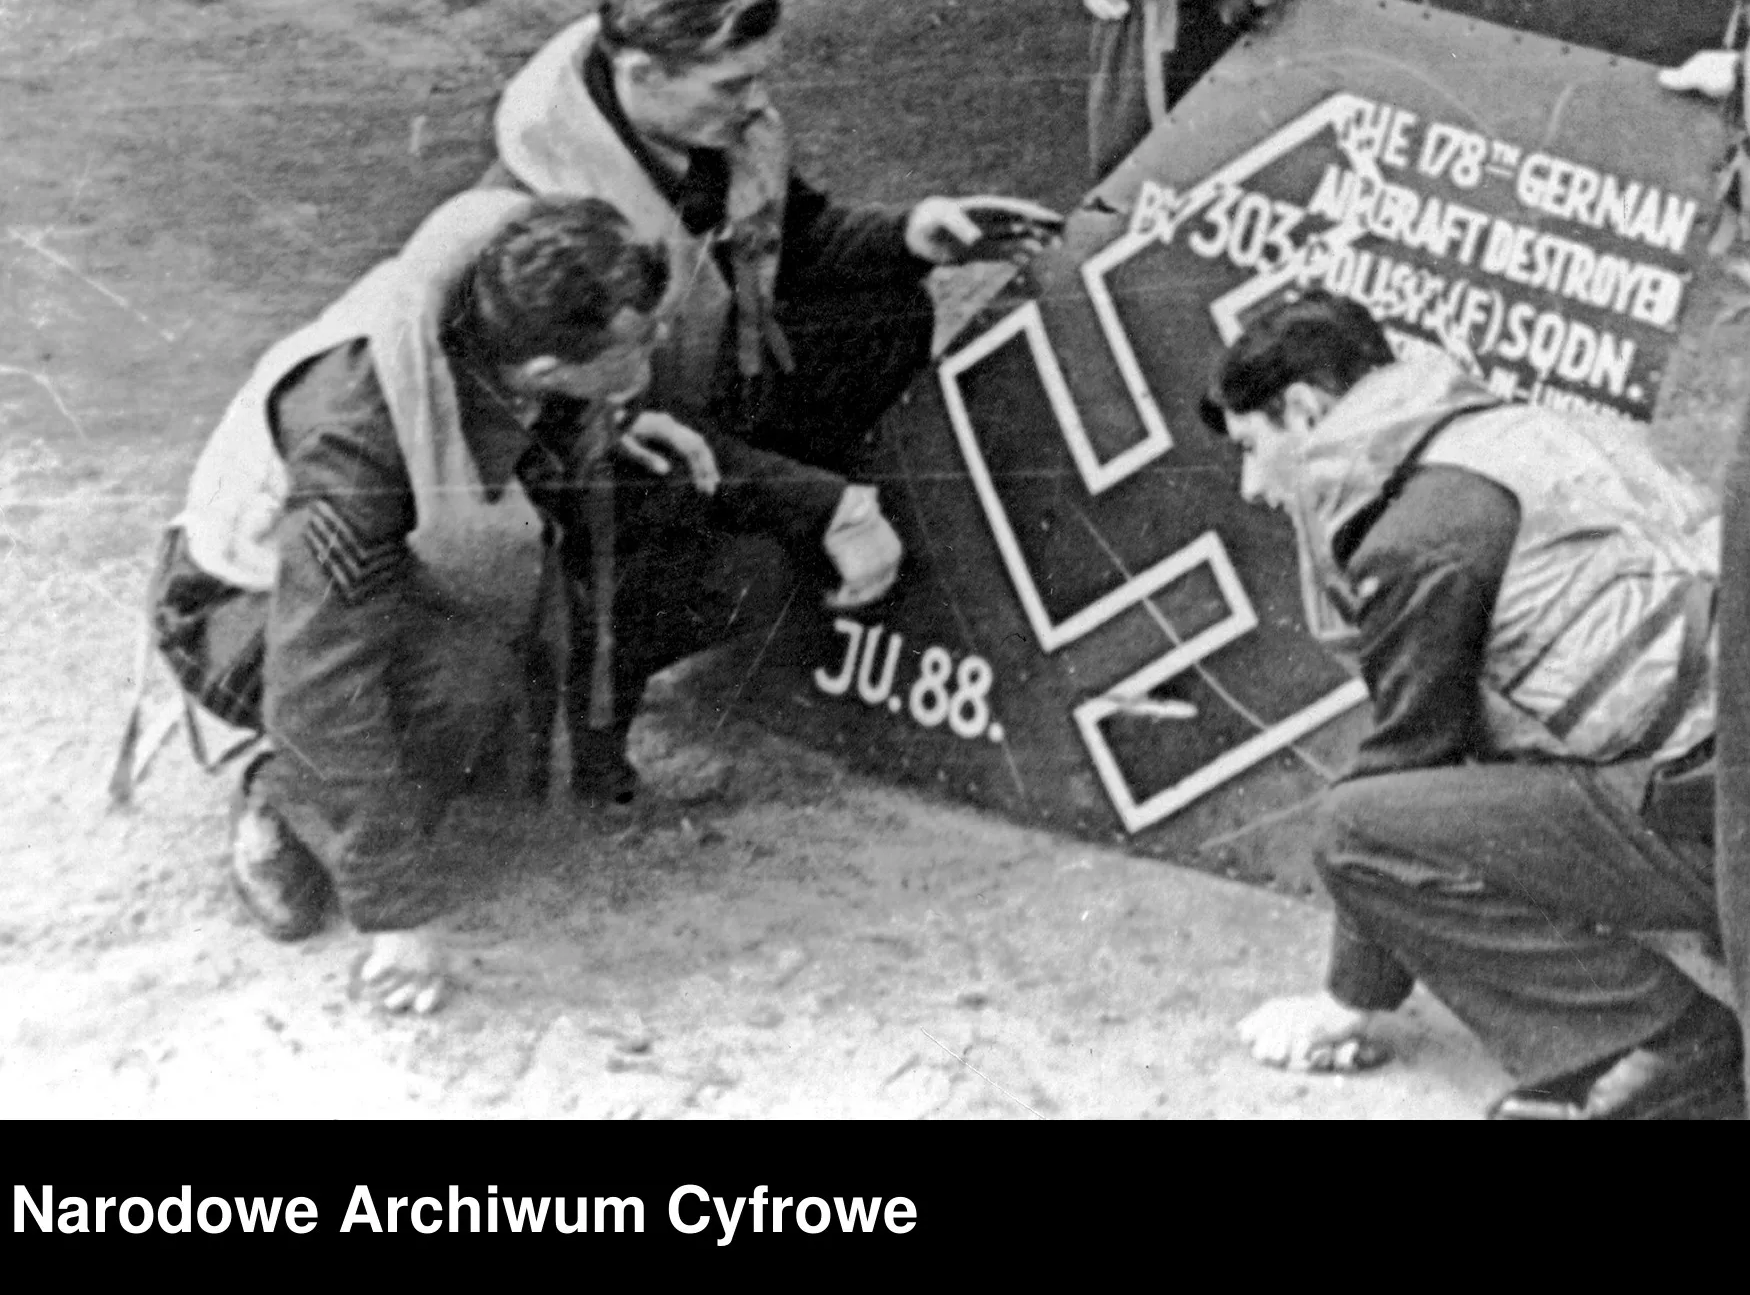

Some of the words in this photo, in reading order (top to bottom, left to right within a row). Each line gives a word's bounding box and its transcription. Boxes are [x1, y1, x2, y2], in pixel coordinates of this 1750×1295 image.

[1306, 165, 1490, 267] AIRCRAFT
[1480, 218, 1686, 328] DESTROYED
[1337, 95, 1417, 168] THE
[1517, 153, 1698, 253] GERMAN
[1130, 179, 1178, 243] BY
[1188, 183, 1304, 275] 303
[1498, 302, 1645, 402] SQDN.
